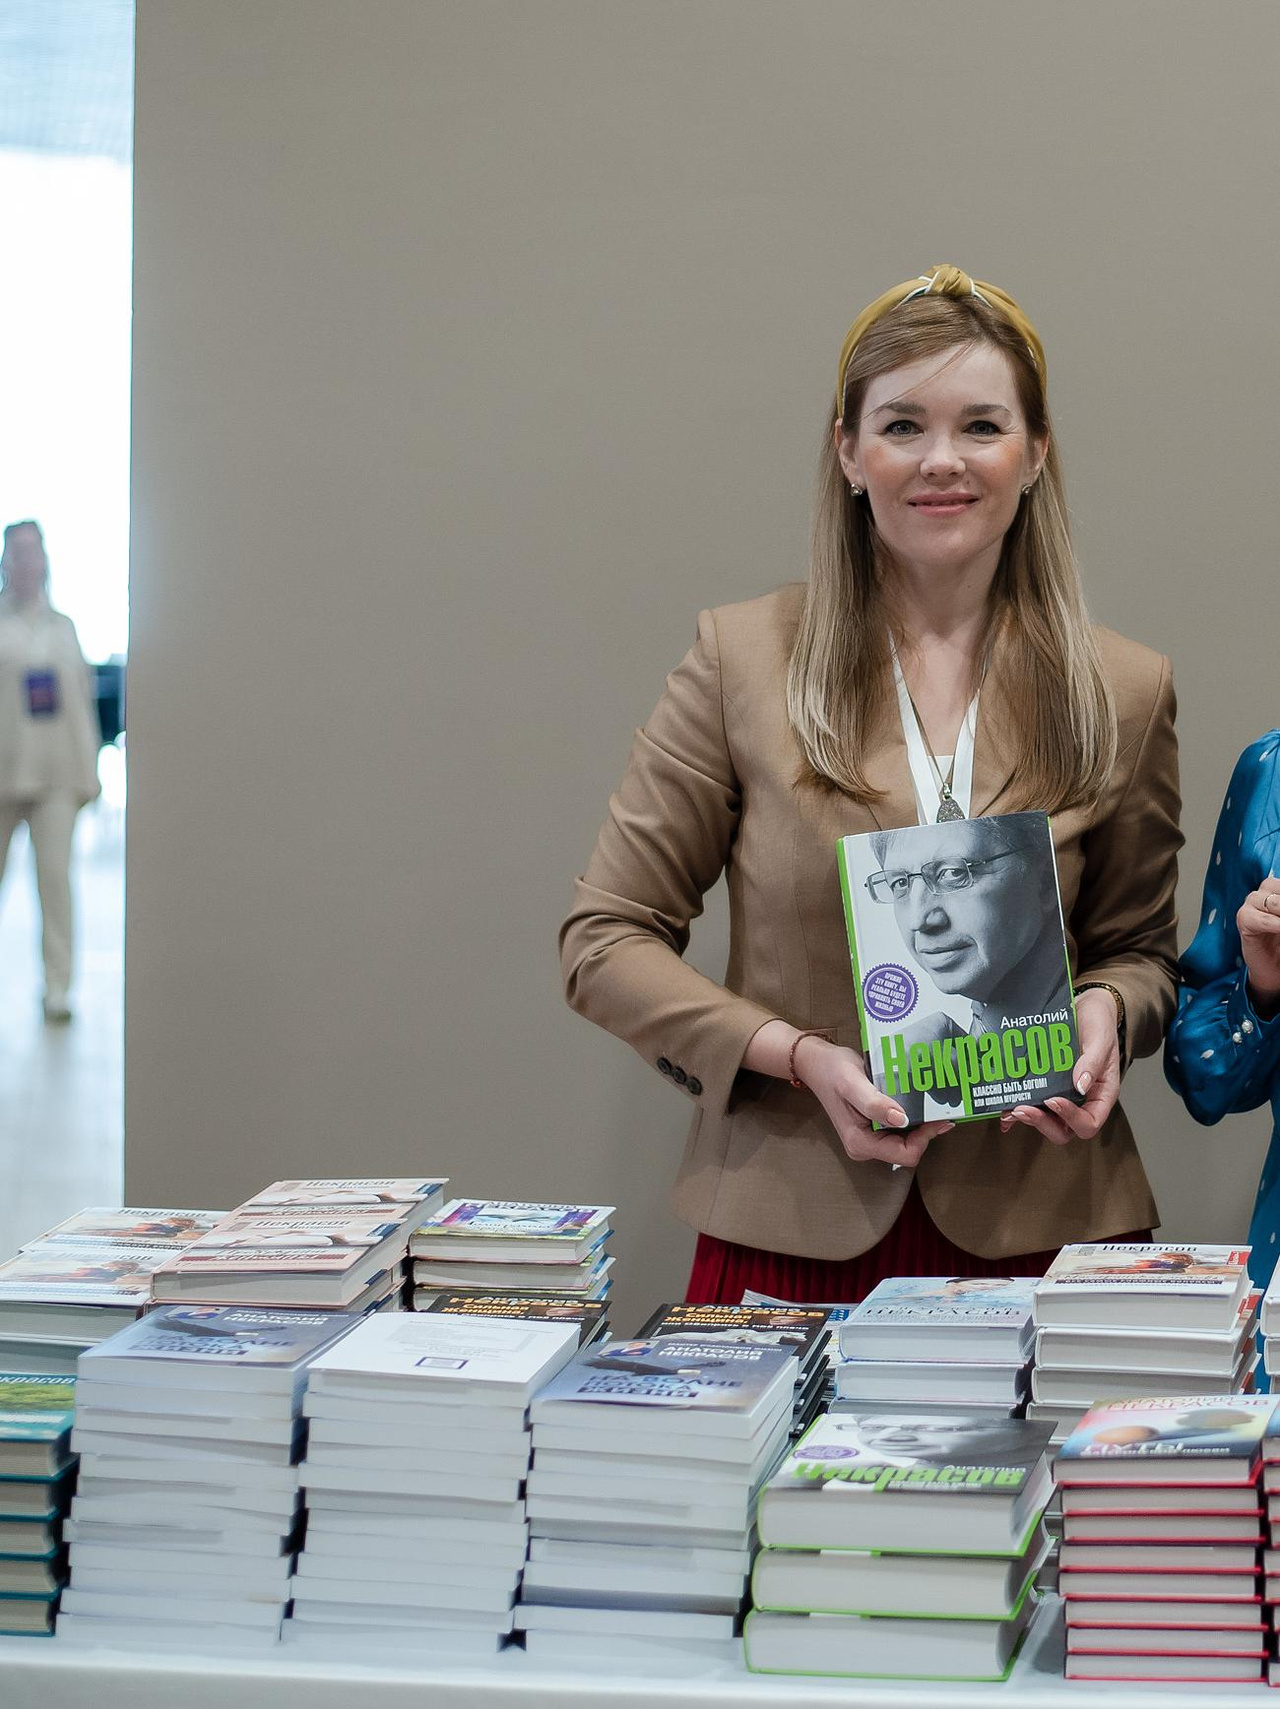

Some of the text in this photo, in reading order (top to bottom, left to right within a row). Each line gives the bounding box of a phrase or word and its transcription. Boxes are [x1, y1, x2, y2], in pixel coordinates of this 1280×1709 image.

[1000, 1008, 1069, 1030] Анатолий
[880, 1023, 1075, 1116] Некрасов
[1003, 1081, 1022, 1093] БЫТЬ
[255, 1221, 351, 1229] Некрасов
[229, 1313, 330, 1321] АНАТОЛИЙ
[657, 1350, 761, 1361] НЕКРАСОВ
[662, 1346, 764, 1356] АНАТОЛИЙ
[0, 1376, 75, 1384] красов
[792, 1462, 1026, 1493] Некрасов
